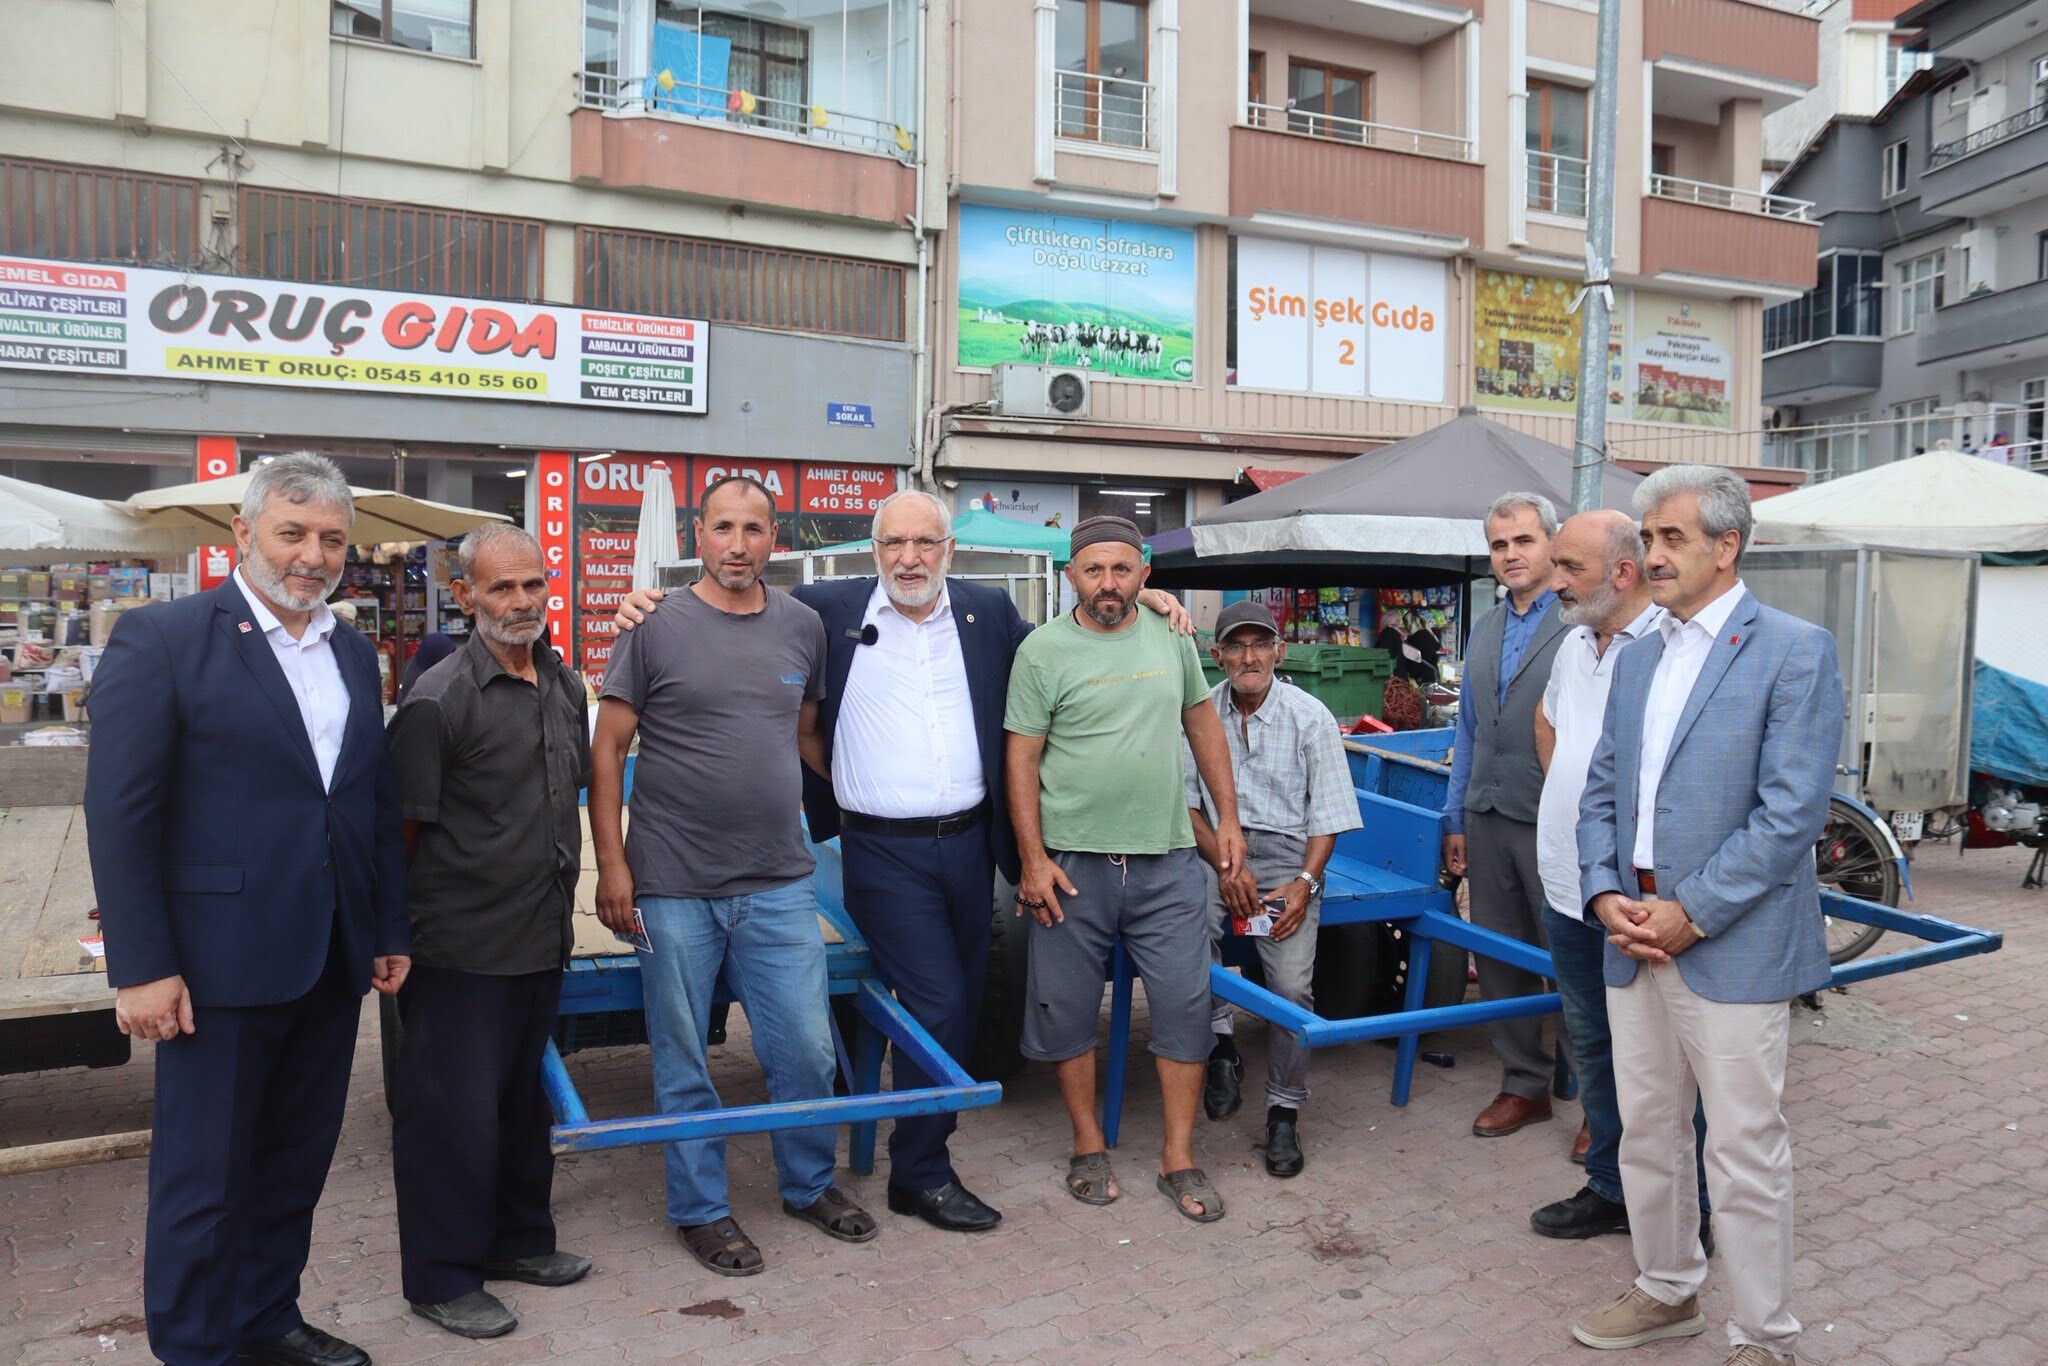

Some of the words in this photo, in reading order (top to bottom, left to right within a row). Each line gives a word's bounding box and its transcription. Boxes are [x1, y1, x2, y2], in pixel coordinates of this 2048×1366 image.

[1005, 225, 1092, 250] Çiftlikten
[1096, 236, 1174, 260] Sofralara
[1033, 249, 1086, 271] Doğal
[1090, 255, 1148, 276] Lezzet
[62, 272, 119, 289] GIDA
[49, 297, 122, 314] ÇEŞİTLERİ
[148, 284, 373, 356] ORUÇ
[382, 302, 557, 360] GIDA
[1372, 302, 1435, 332] Gıda
[63, 321, 122, 340] ÜRÜNLER
[586, 318, 634, 333] TEMİZLİK
[636, 321, 686, 336] ÜRÜNLERİ
[47, 348, 120, 365] ÇEŞİTLERİ
[588, 340, 635, 354] AMBALAJ
[638, 342, 688, 358] ÜRÜNLERİ
[1339, 339, 1355, 365] 2
[177, 354, 270, 372] AHMET
[279, 361, 356, 380] ORUÇ:
[365, 366, 421, 383] 0545
[429, 371, 470, 385] 410
[479, 374, 504, 388] 55
[512, 376, 538, 390] 60
[588, 363, 626, 377] POŞET
[628, 365, 685, 380] ÇEŞİTLERİ
[591, 385, 618, 398] YEM
[622, 387, 686, 402] ÇEŞİTLERİ
[835, 412, 865, 423] SOKAK
[584, 462, 672, 492] ORU
[806, 468, 848, 481] AHMET
[852, 470, 884, 485] ORUÇ
[829, 484, 862, 496] 0545
[809, 497, 839, 509] 410
[844, 498, 863, 510] 55
[994, 501, 1040, 514] chwarzkopf
[589, 538, 630, 550] TOPLU
[587, 646, 612, 659] PLAST
